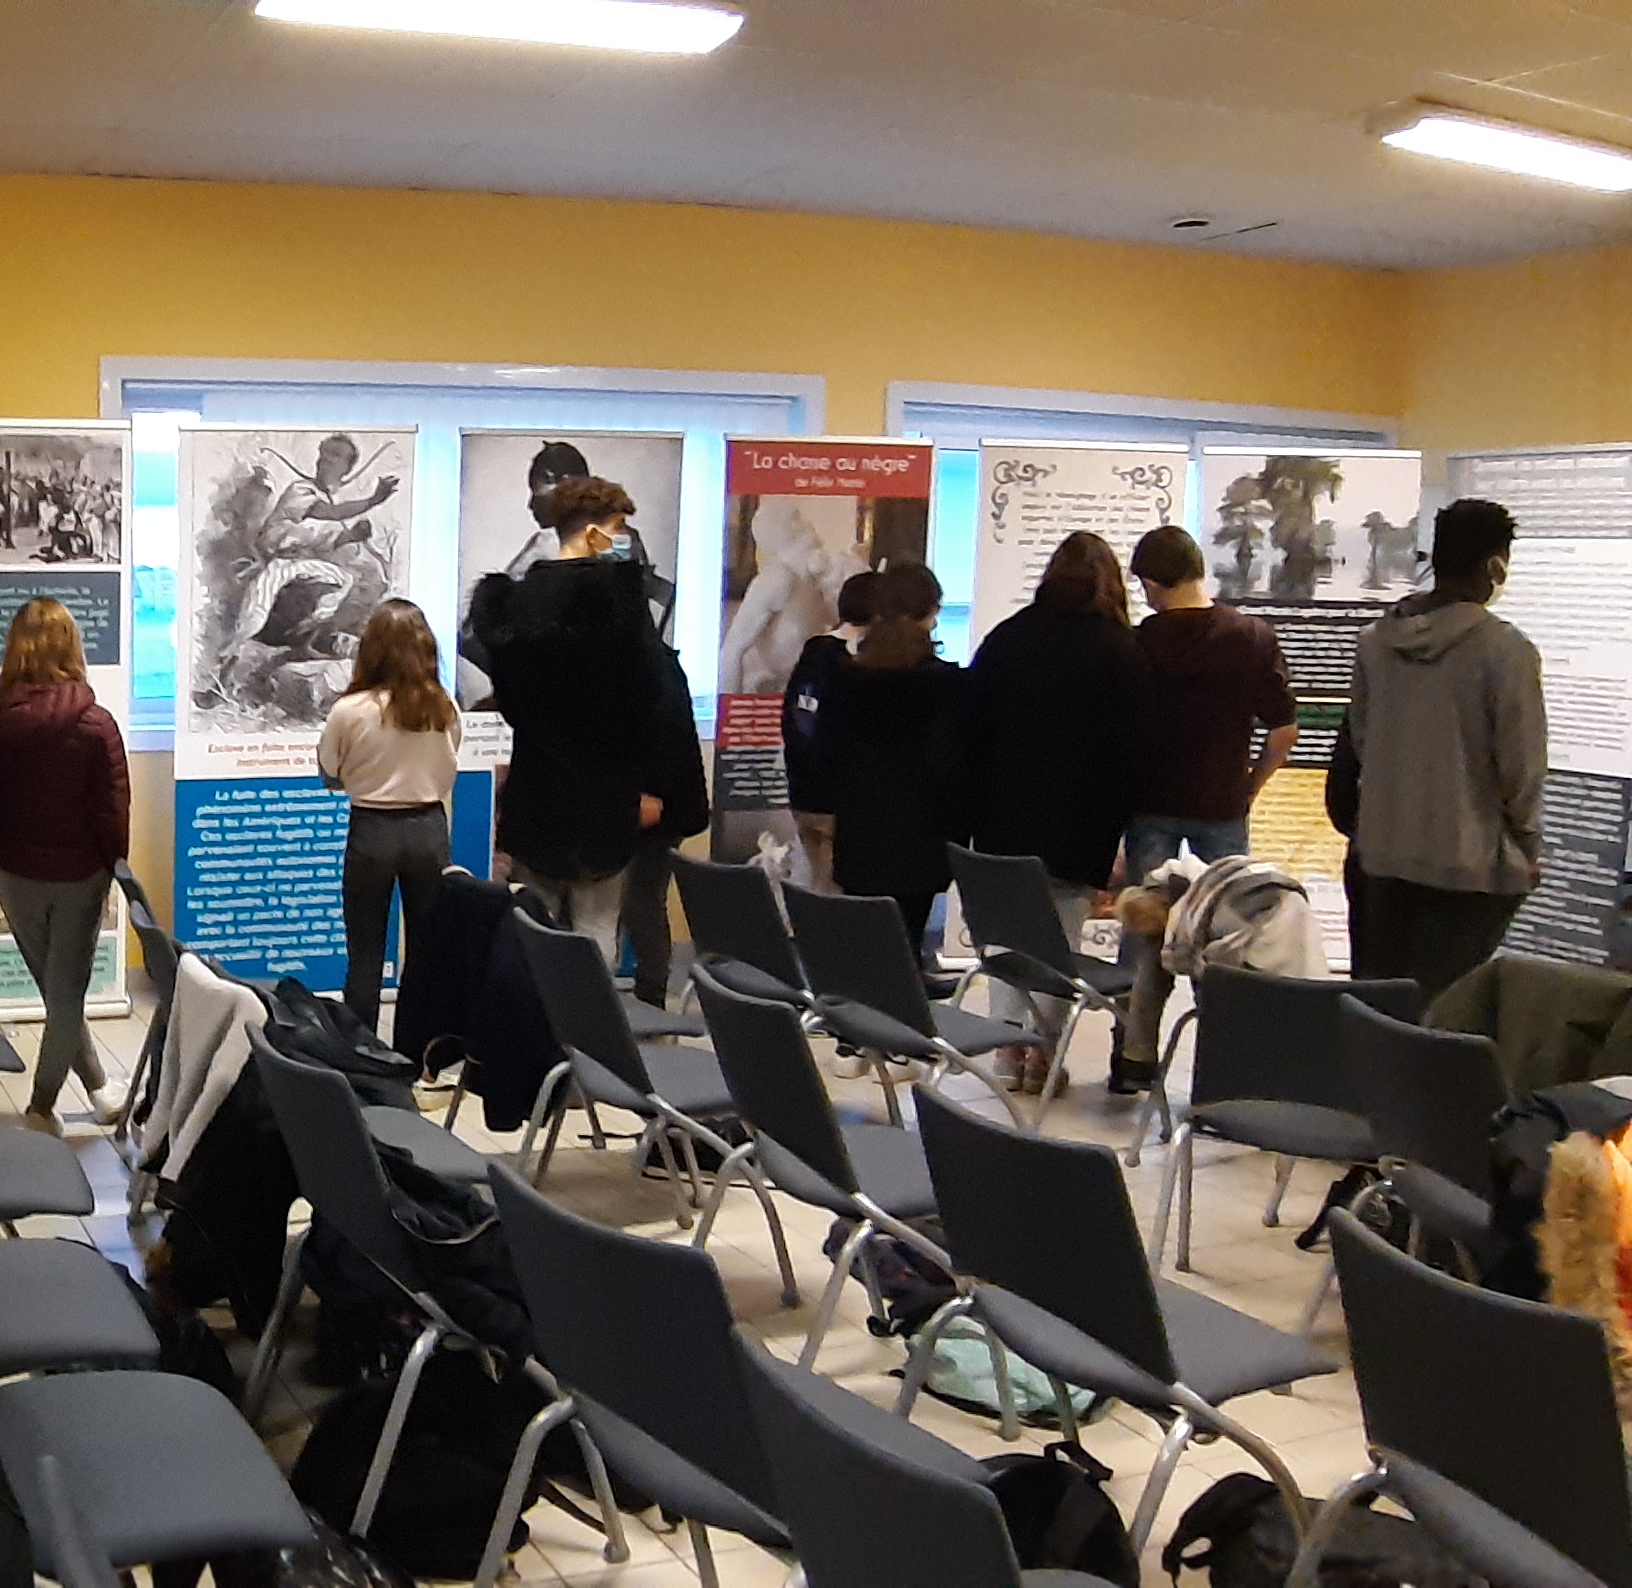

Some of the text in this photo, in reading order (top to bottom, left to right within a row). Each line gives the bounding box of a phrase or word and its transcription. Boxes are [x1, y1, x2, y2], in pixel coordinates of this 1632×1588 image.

[744, 450, 917, 476] "La chasse au nègre"
